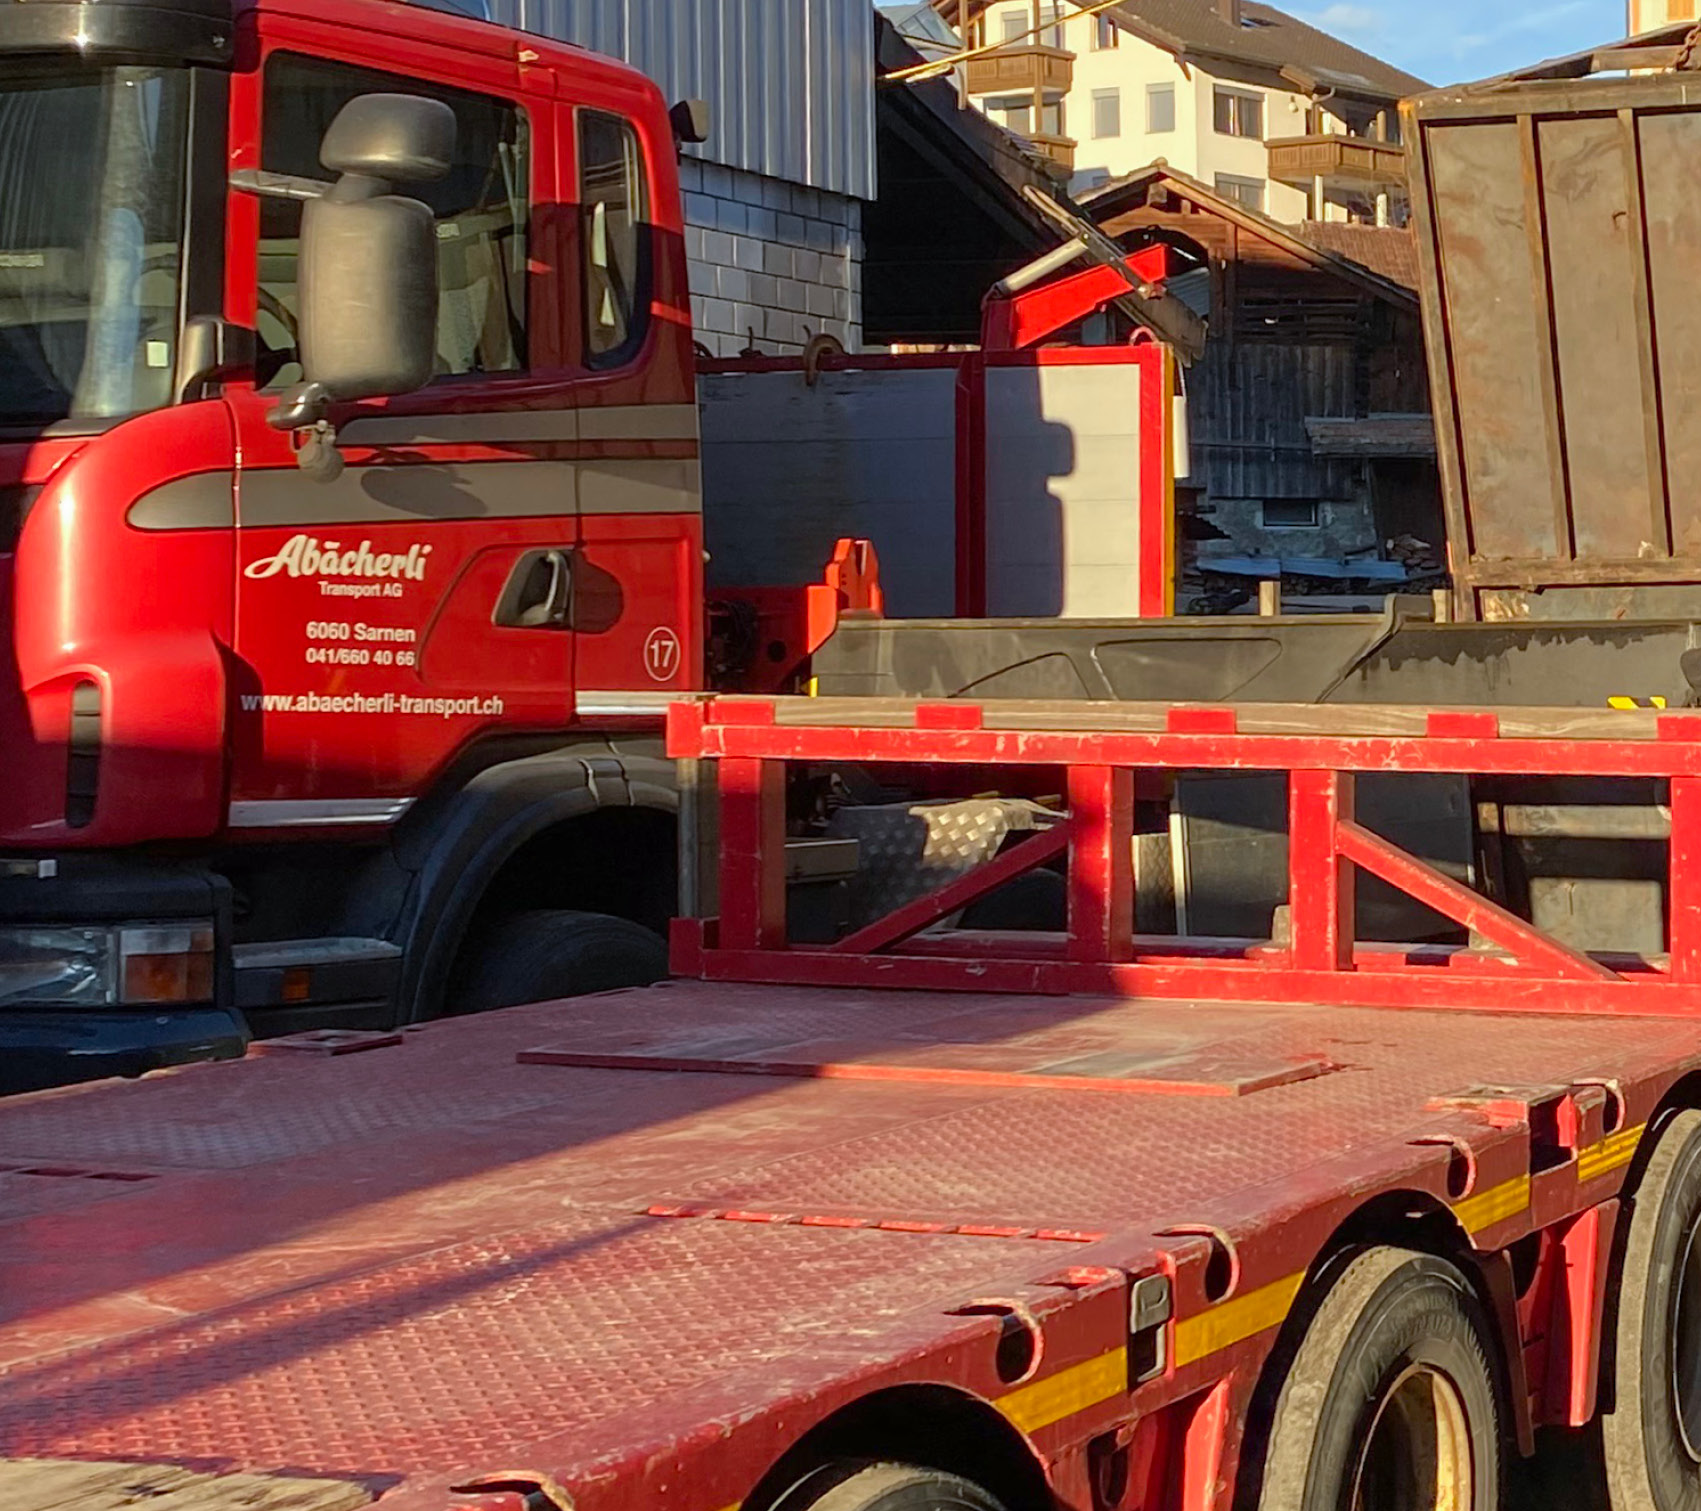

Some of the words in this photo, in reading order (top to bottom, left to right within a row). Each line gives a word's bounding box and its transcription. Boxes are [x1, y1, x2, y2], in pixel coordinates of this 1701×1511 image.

[317, 581, 381, 599] Transport
[382, 583, 403, 598] AG
[305, 621, 350, 640] 6060
[353, 622, 416, 642] Sarnen
[305, 647, 370, 665] 041/660
[373, 649, 393, 666] 40
[395, 650, 416, 666] 66
[650, 639, 675, 668] 17
[240, 691, 504, 719] www.abaecherli-transport.ch
